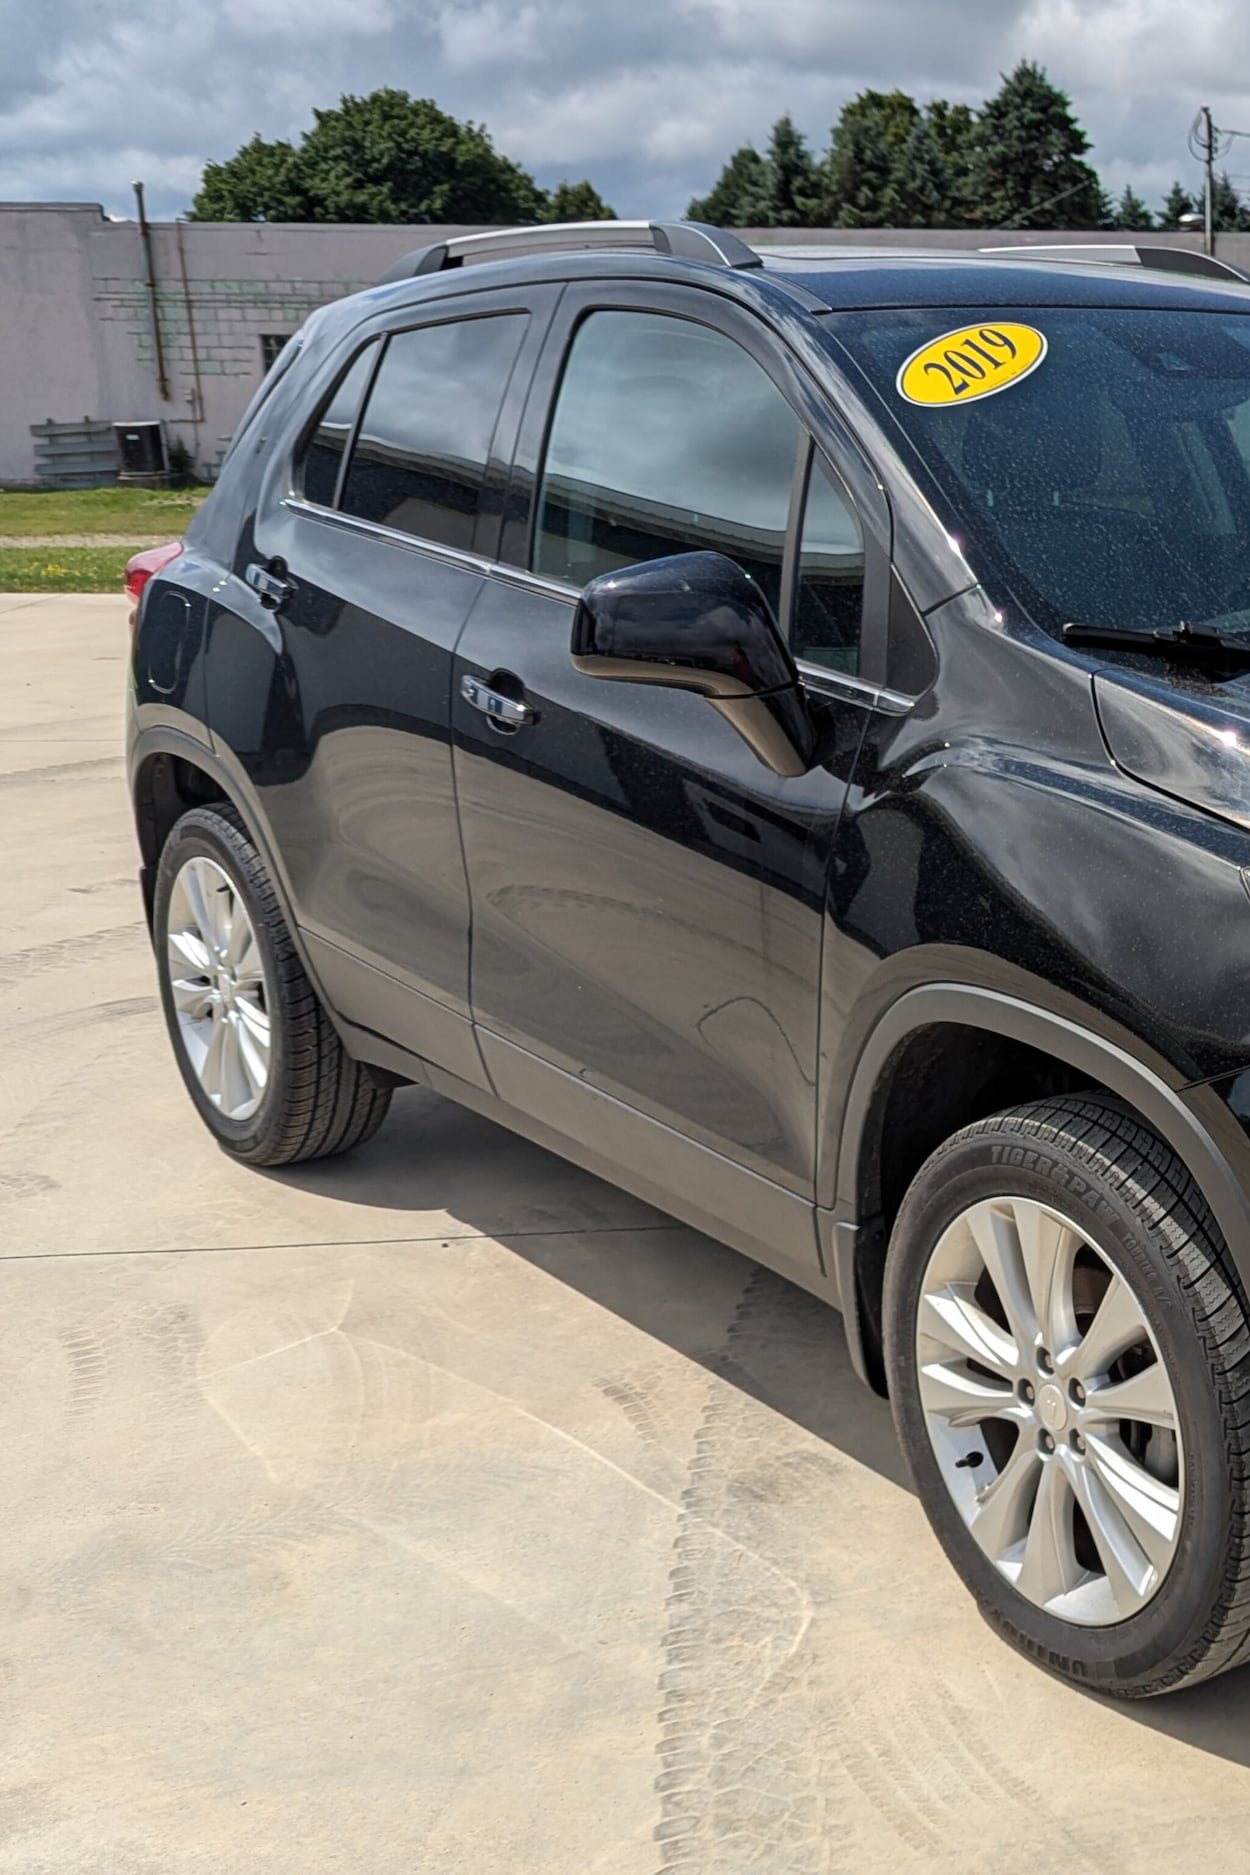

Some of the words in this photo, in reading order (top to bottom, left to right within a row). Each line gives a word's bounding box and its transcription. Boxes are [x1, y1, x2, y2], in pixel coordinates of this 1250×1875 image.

[923, 328, 1017, 395] 2019
[991, 1145, 1051, 1178] TIGER
[1068, 1175, 1120, 1225] PAW
